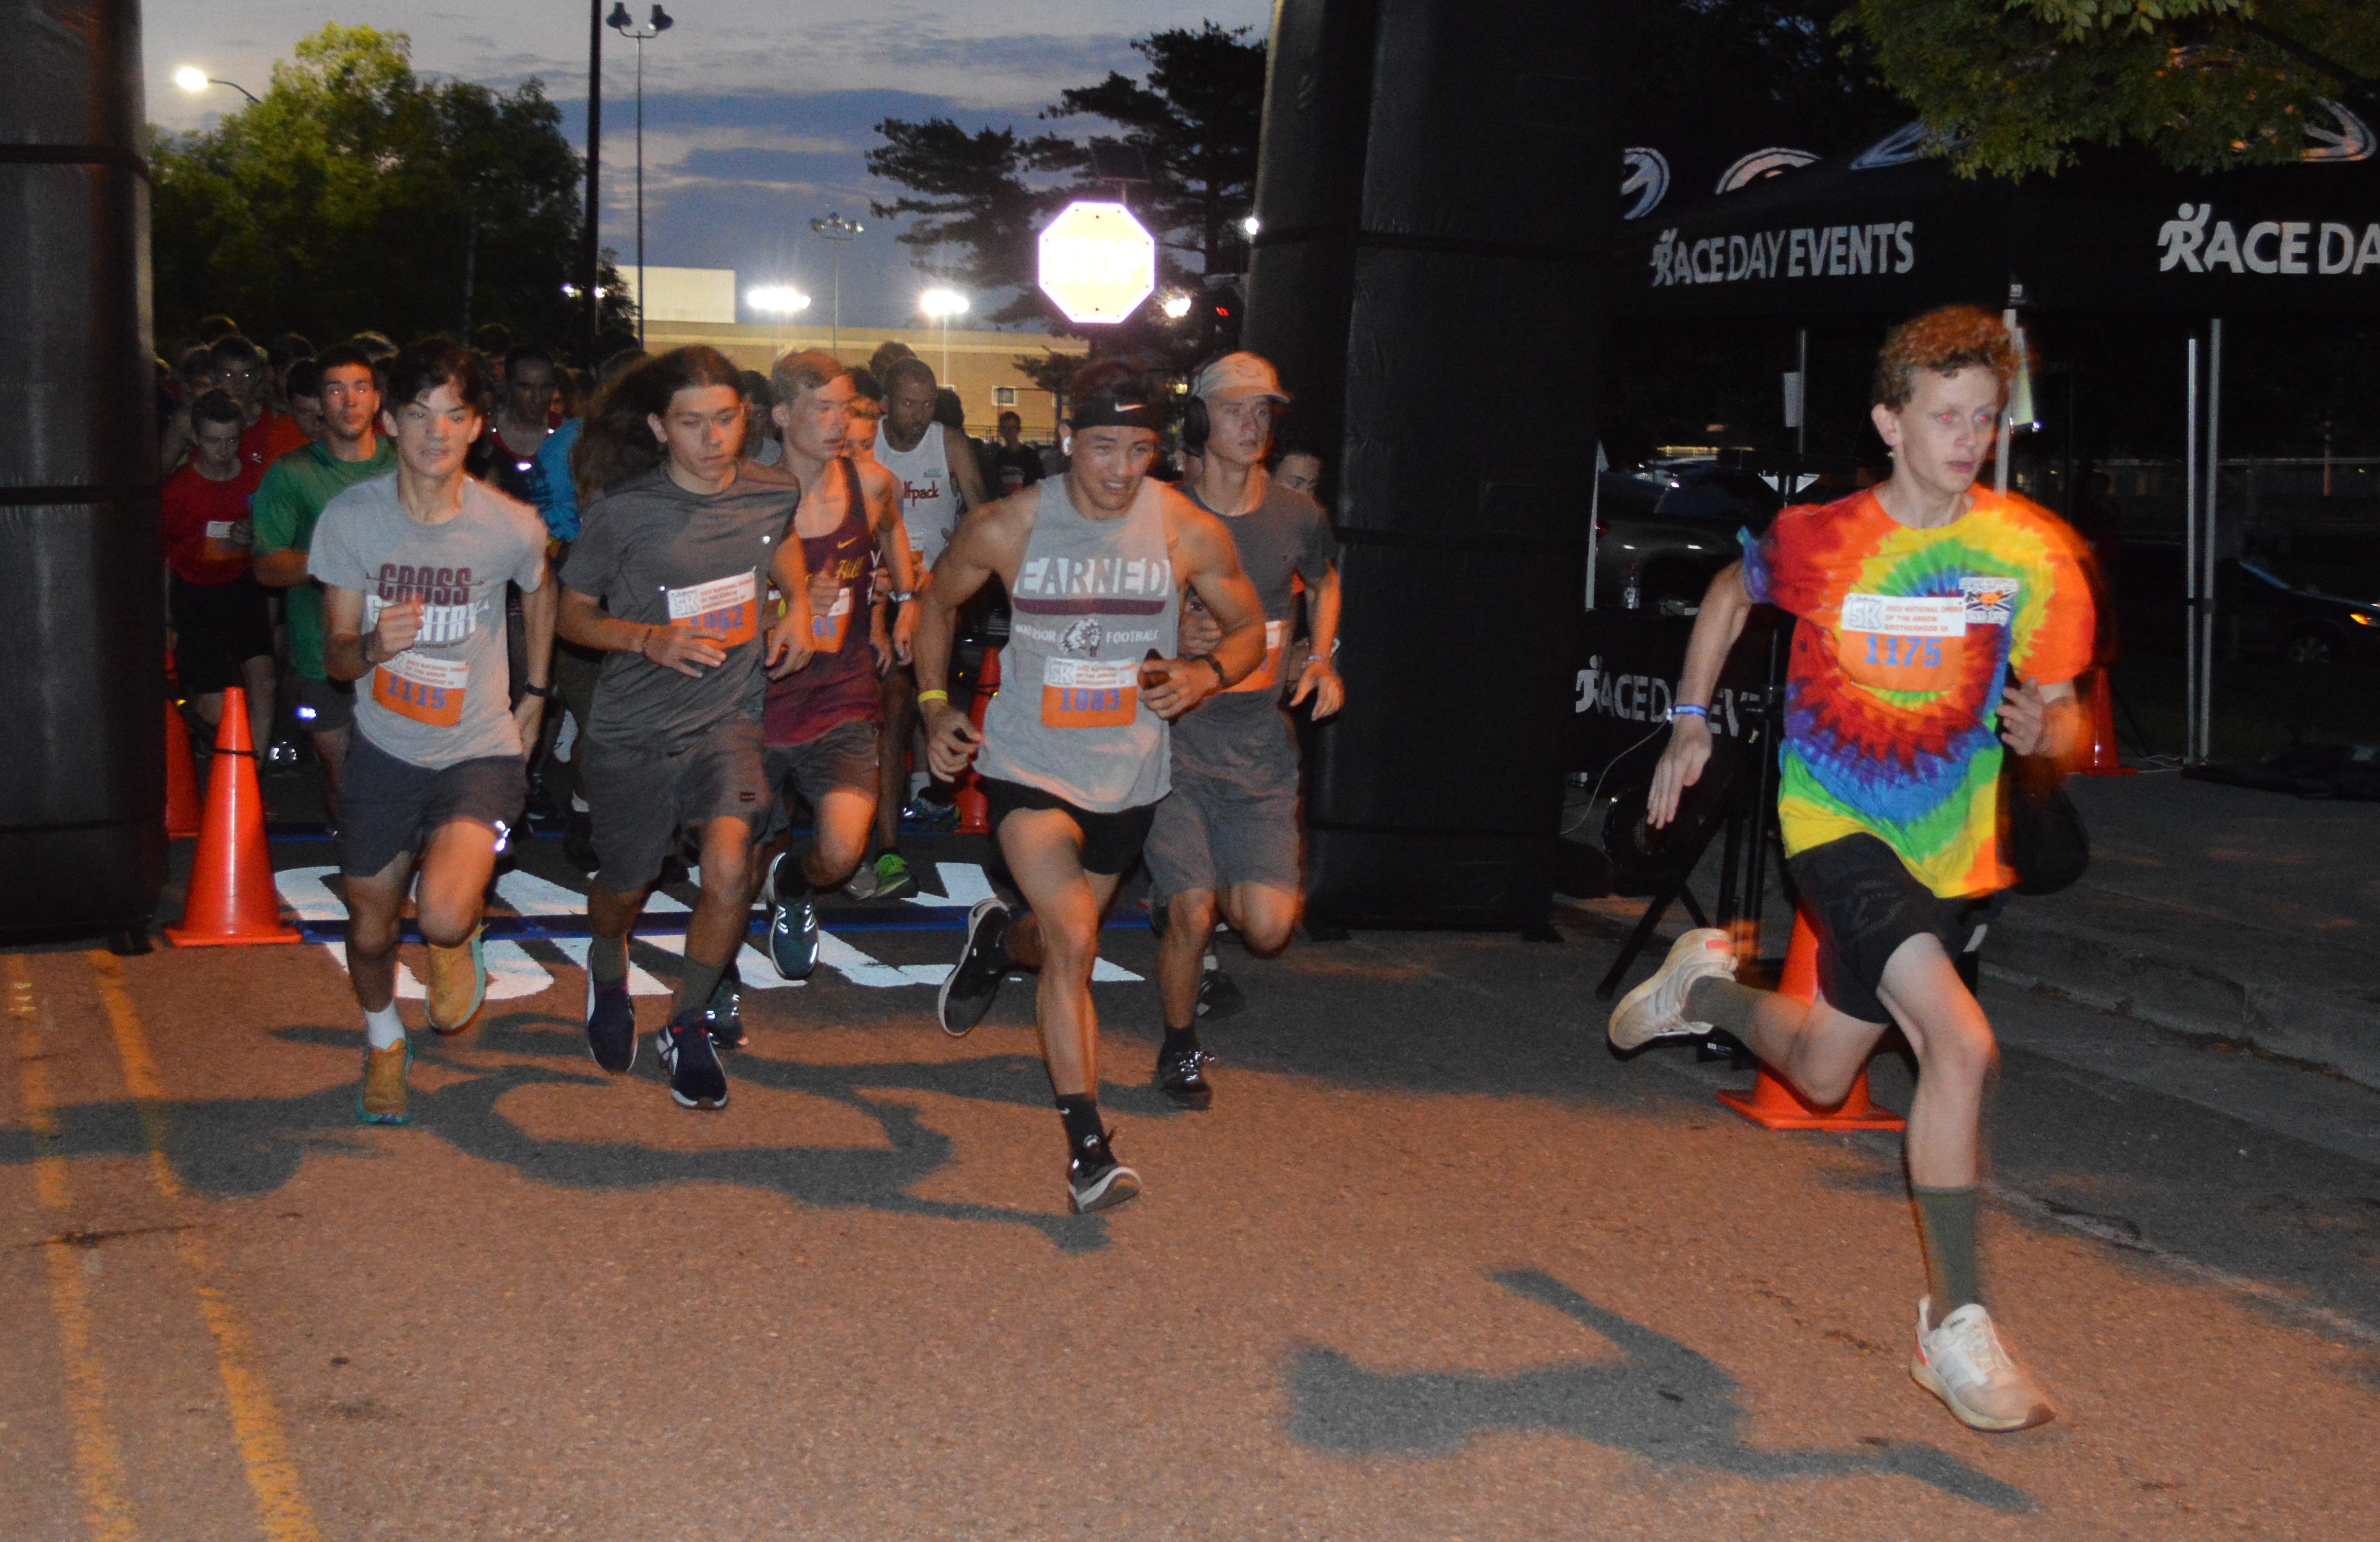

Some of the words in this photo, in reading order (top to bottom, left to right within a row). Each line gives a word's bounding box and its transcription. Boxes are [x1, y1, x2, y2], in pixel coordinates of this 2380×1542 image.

[1047, 236, 1147, 285] STOP
[1788, 221, 1914, 277] EVENTS
[378, 563, 471, 605] CROSS
[1012, 557, 1171, 596] EARNED
[366, 594, 476, 642] CNTRY
[1850, 599, 1882, 629] 5K
[1864, 635, 1941, 667] 1175
[388, 675, 448, 709] 1115
[1060, 688, 1119, 711] 1083
